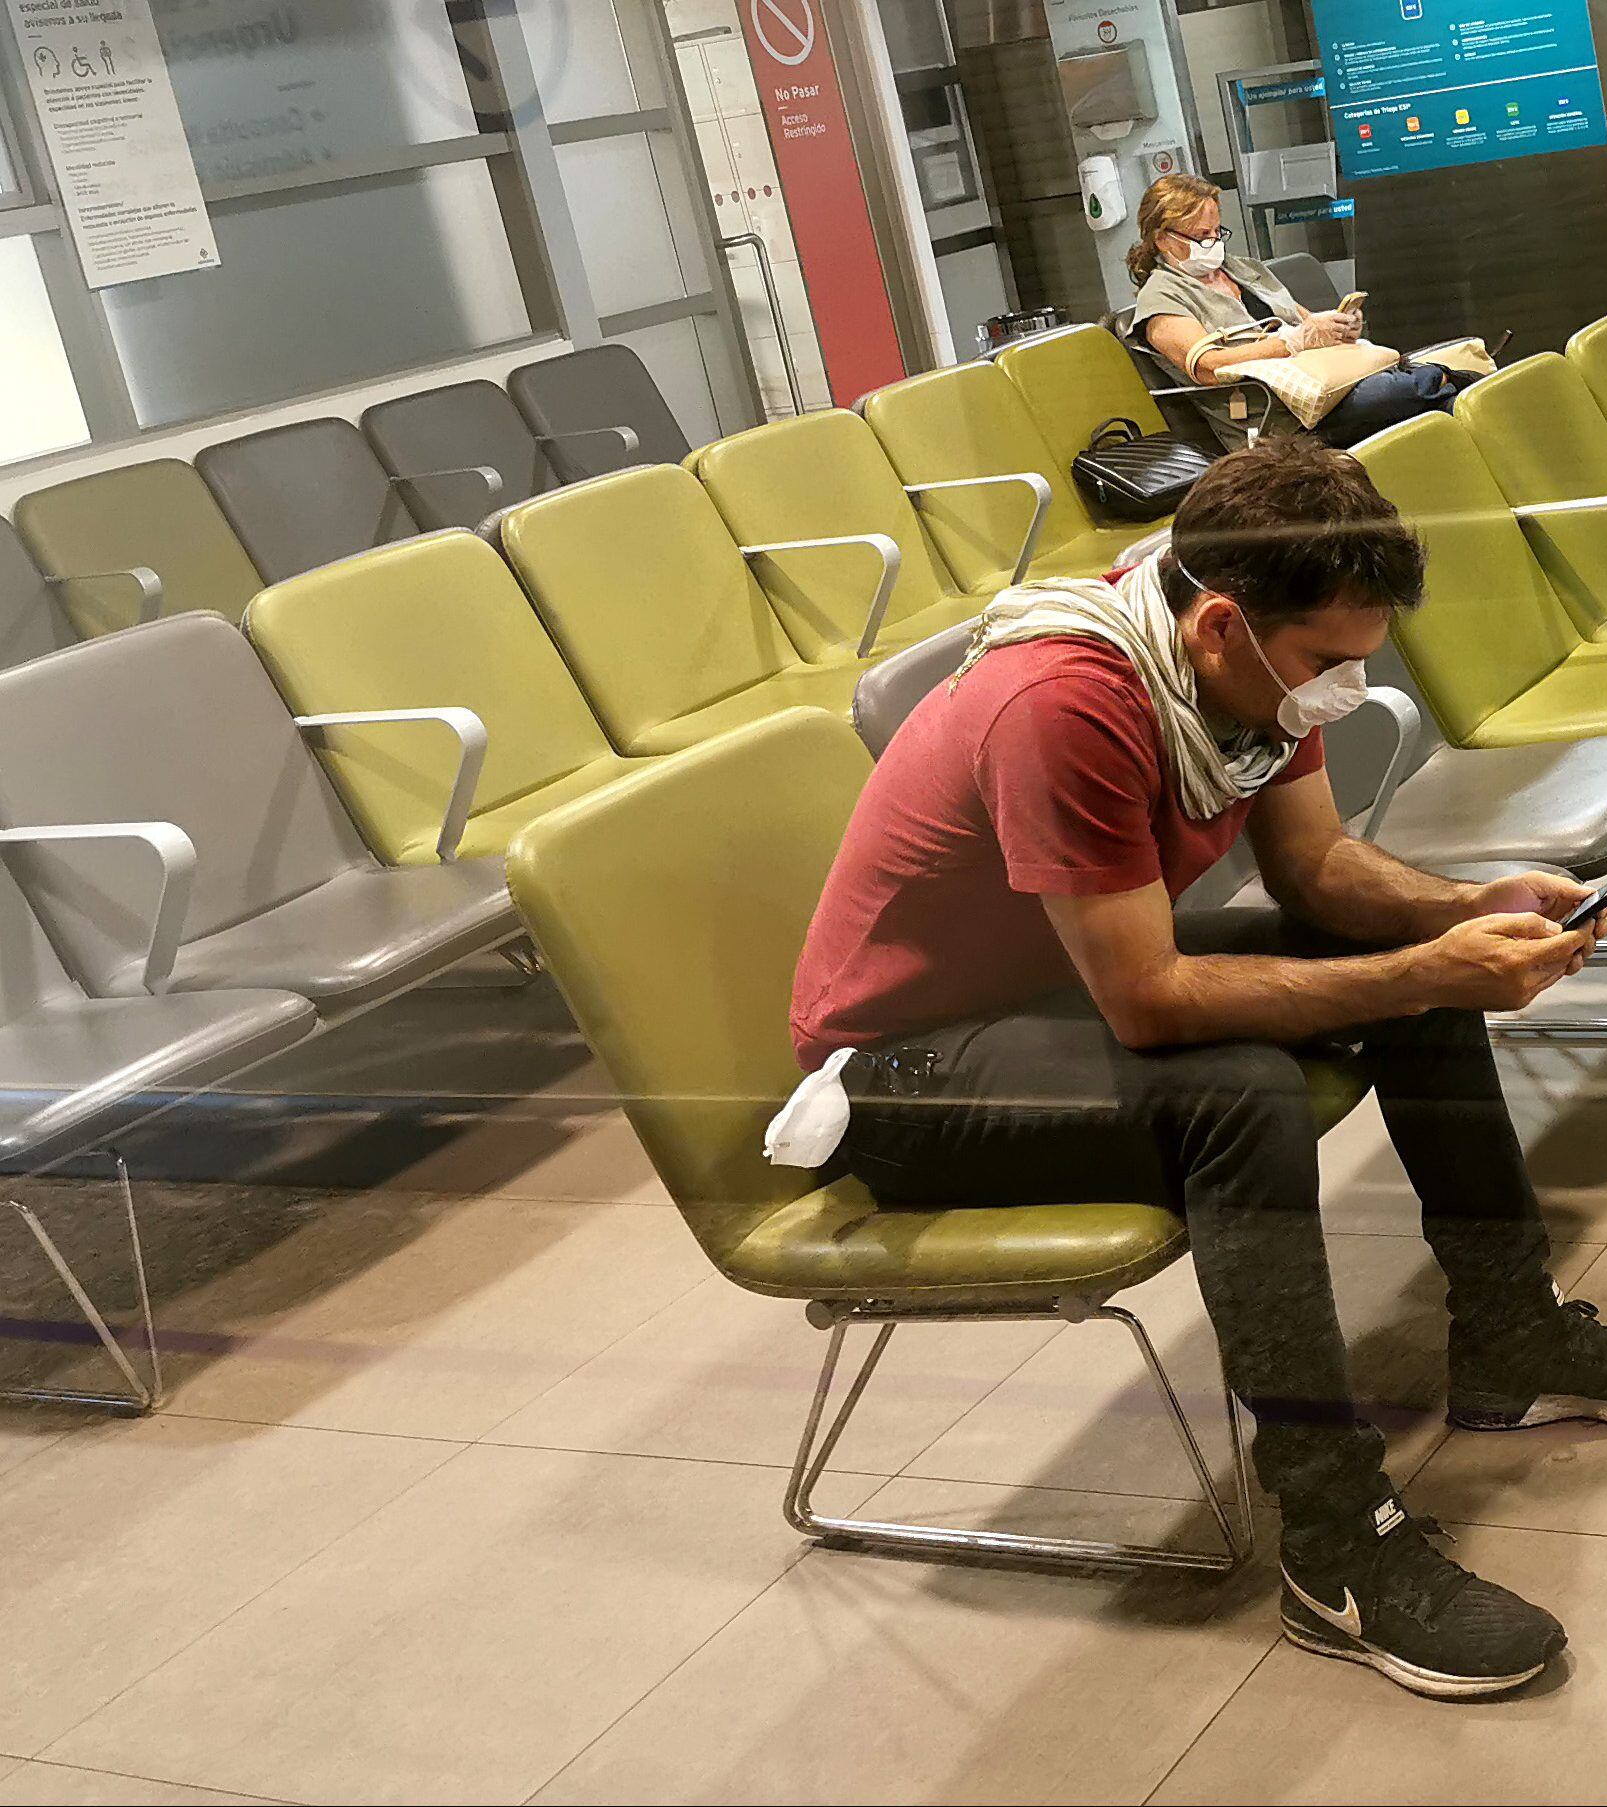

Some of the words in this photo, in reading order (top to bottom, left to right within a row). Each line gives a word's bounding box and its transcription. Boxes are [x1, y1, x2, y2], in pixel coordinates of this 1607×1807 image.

[775, 88, 790, 101] No
[791, 85, 820, 100] Pasar
[781, 113, 809, 126] Acceso
[783, 122, 827, 139] Restringido
[1333, 203, 1353, 213] usted
[1374, 1498, 1397, 1526] NIKE
